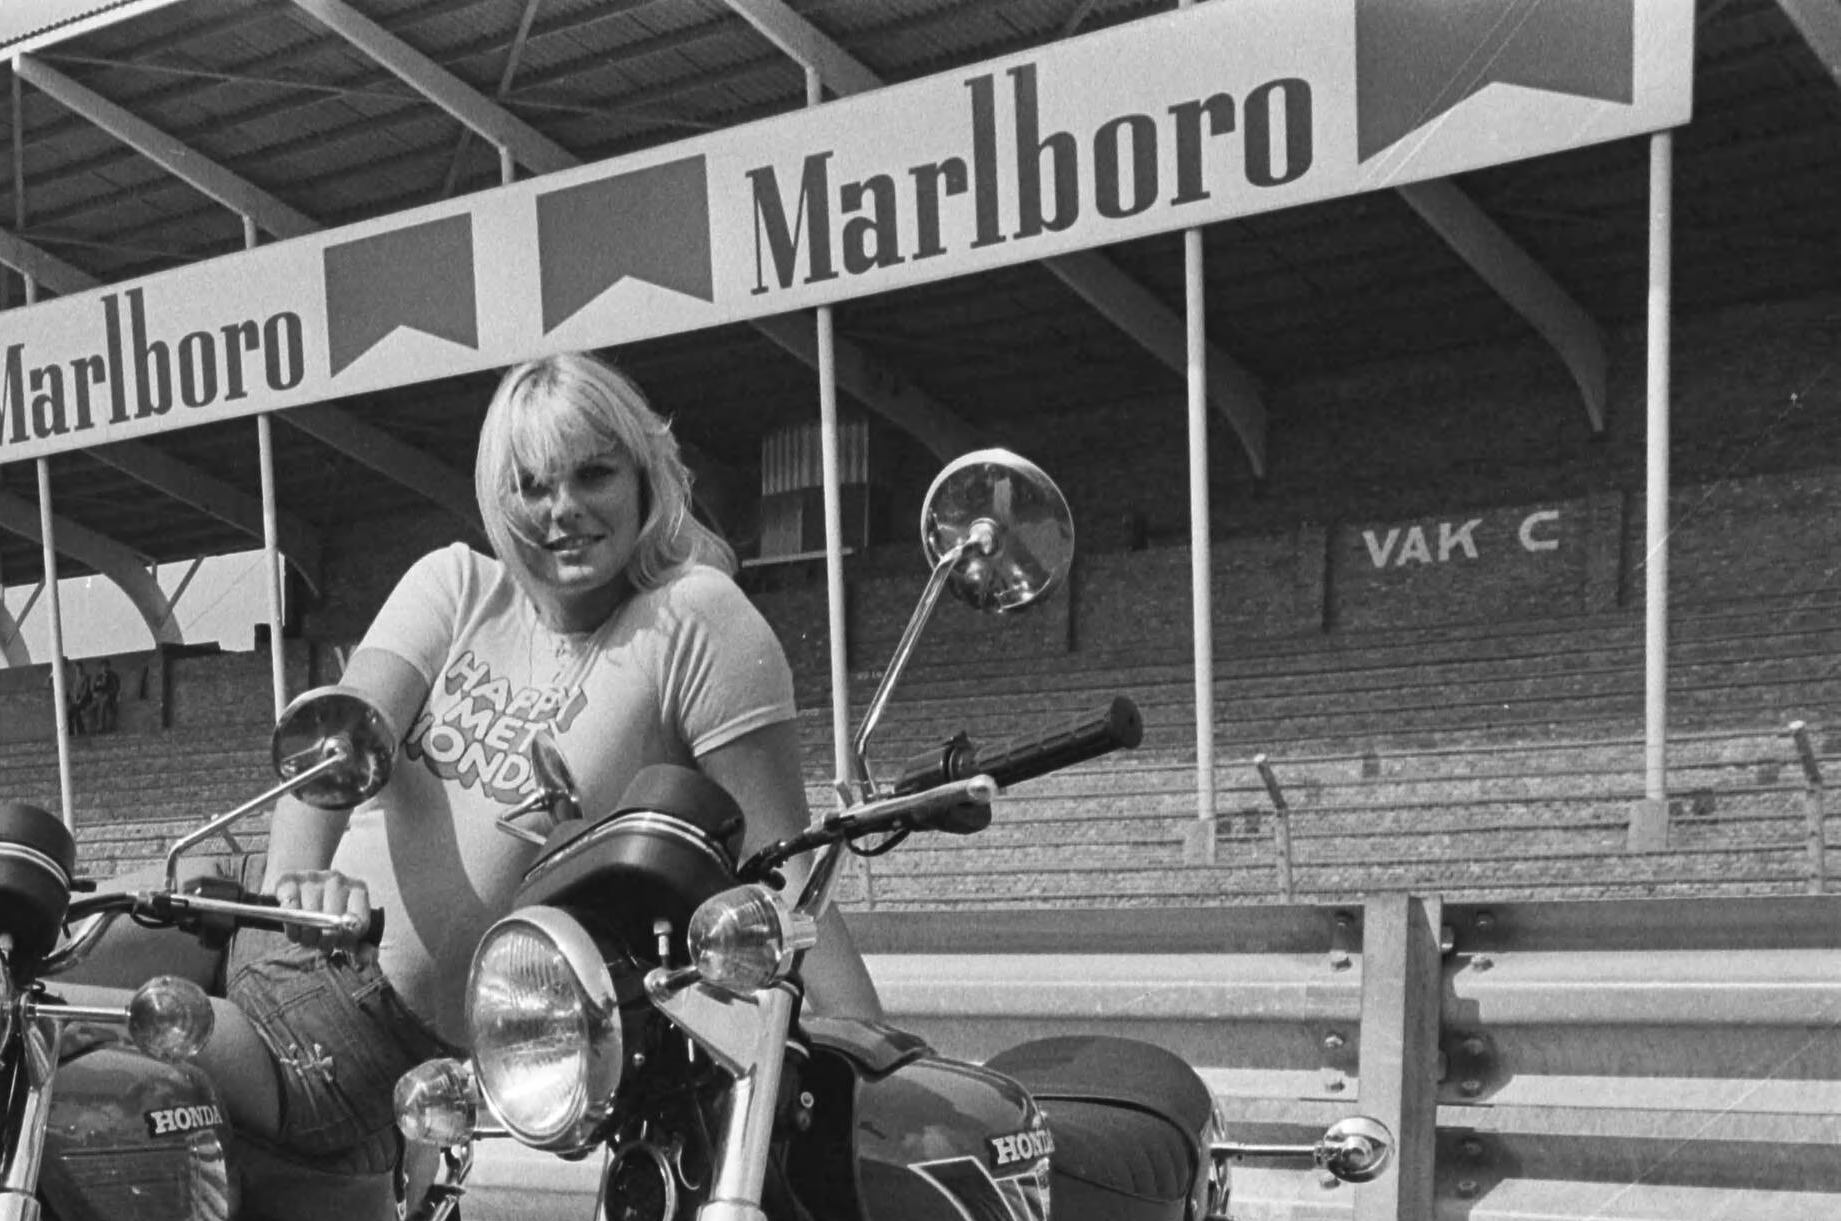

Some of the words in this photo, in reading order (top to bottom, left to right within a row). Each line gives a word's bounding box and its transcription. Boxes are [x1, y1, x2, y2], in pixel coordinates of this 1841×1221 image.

[745, 62, 1314, 297] Marlboro
[1361, 517, 1483, 568] VAK
[1518, 510, 1559, 551] C
[443, 696, 549, 753] MET
[445, 650, 585, 730] HAPPY
[408, 713, 537, 802] OND
[150, 1104, 224, 1135] HONDA
